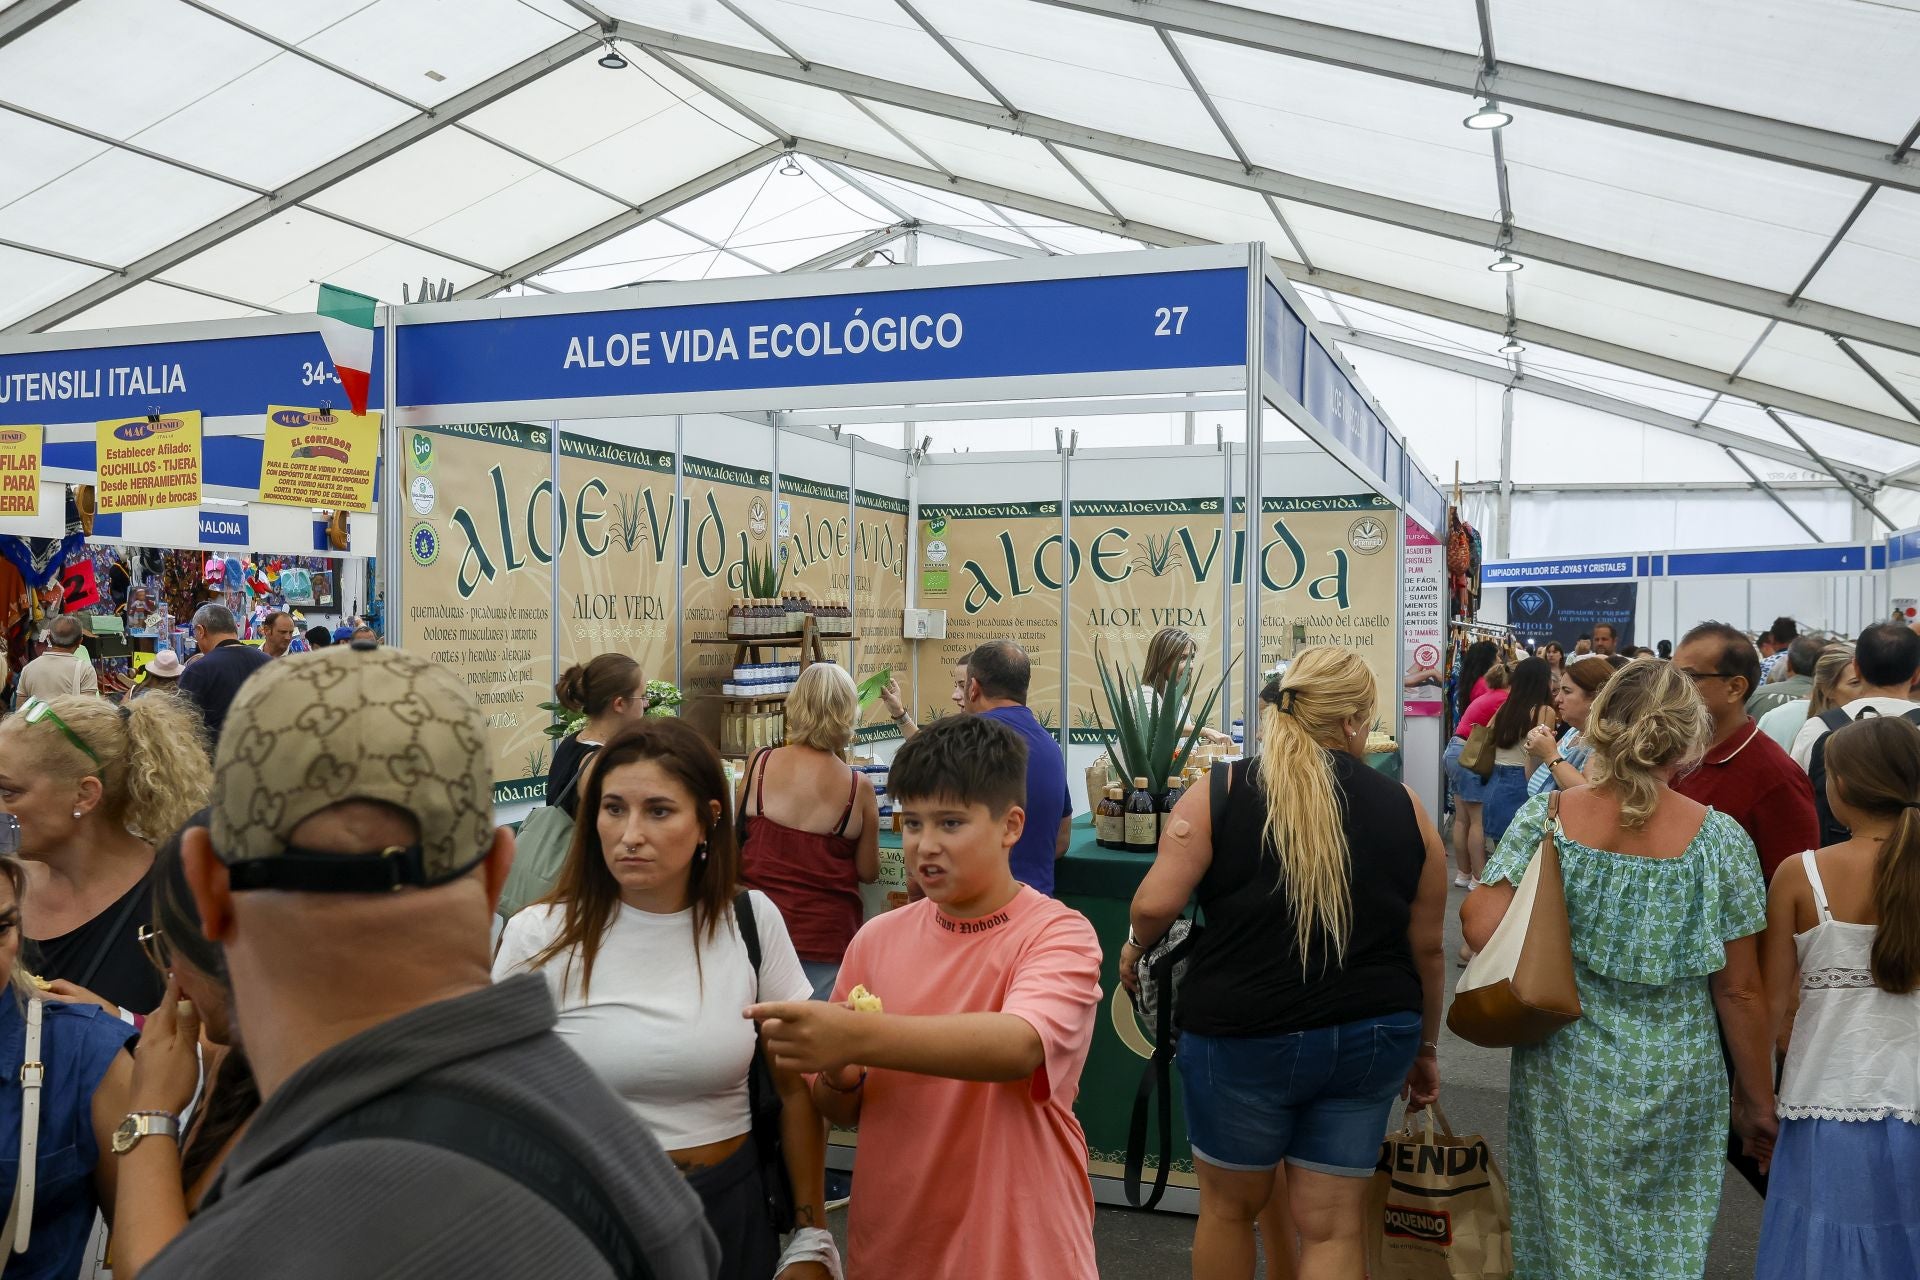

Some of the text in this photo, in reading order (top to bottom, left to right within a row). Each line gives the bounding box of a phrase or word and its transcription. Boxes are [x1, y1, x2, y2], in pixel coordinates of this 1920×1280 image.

[563, 307, 1189, 369] ALOE VIDA ECOLÓGICO 27
[0, 369, 100, 403] UTENSILI
[108, 363, 187, 396] ITALIA
[123, 426, 146, 437] MAC
[290, 437, 302, 448] EL
[414, 440, 431, 456] bio
[106, 442, 192, 460] Establecer Afilado:
[560, 438, 653, 467] www.aloevida.
[100, 456, 197, 477] CUCHILLOS TIJERA
[683, 461, 756, 485] www.aloevida.
[3, 475, 36, 492] PARA
[101, 473, 197, 492] Desde HERRAMIENTAS
[101, 490, 197, 508] DE JARDÍN y de brocas
[1073, 500, 1191, 513] www.aloevida.
[921, 503, 1032, 518] www.aloevida.
[930, 520, 945, 530] bio
[1424, 547, 1432, 555] EN
[1487, 562, 1627, 577] LIMPIADOR PULIDOR DE JOYAS Y CRISTALES
[1416, 575, 1437, 584] FÁCIL
[410, 604, 549, 622] quemaduras picaduras de insectos
[572, 593, 665, 620] ALOE VERA
[976, 618, 1013, 628] picaduras
[1014, 618, 1025, 627] de
[1026, 618, 1058, 627] insectos
[1086, 607, 1207, 627] ALOE VERA
[1335, 614, 1351, 628] del
[1353, 614, 1390, 628] cabello
[423, 626, 458, 641] dolores
[459, 627, 504, 641] musculares
[966, 630, 1009, 640] musculares
[1329, 633, 1341, 646] de
[1343, 634, 1352, 646] la
[1355, 634, 1374, 649] piel
[468, 648, 497, 662] heridas
[943, 644, 967, 653] cortes
[508, 668, 518, 682] de
[959, 912, 1011, 934] Nobody
[1384, 1209, 1446, 1233] OQUENDO
